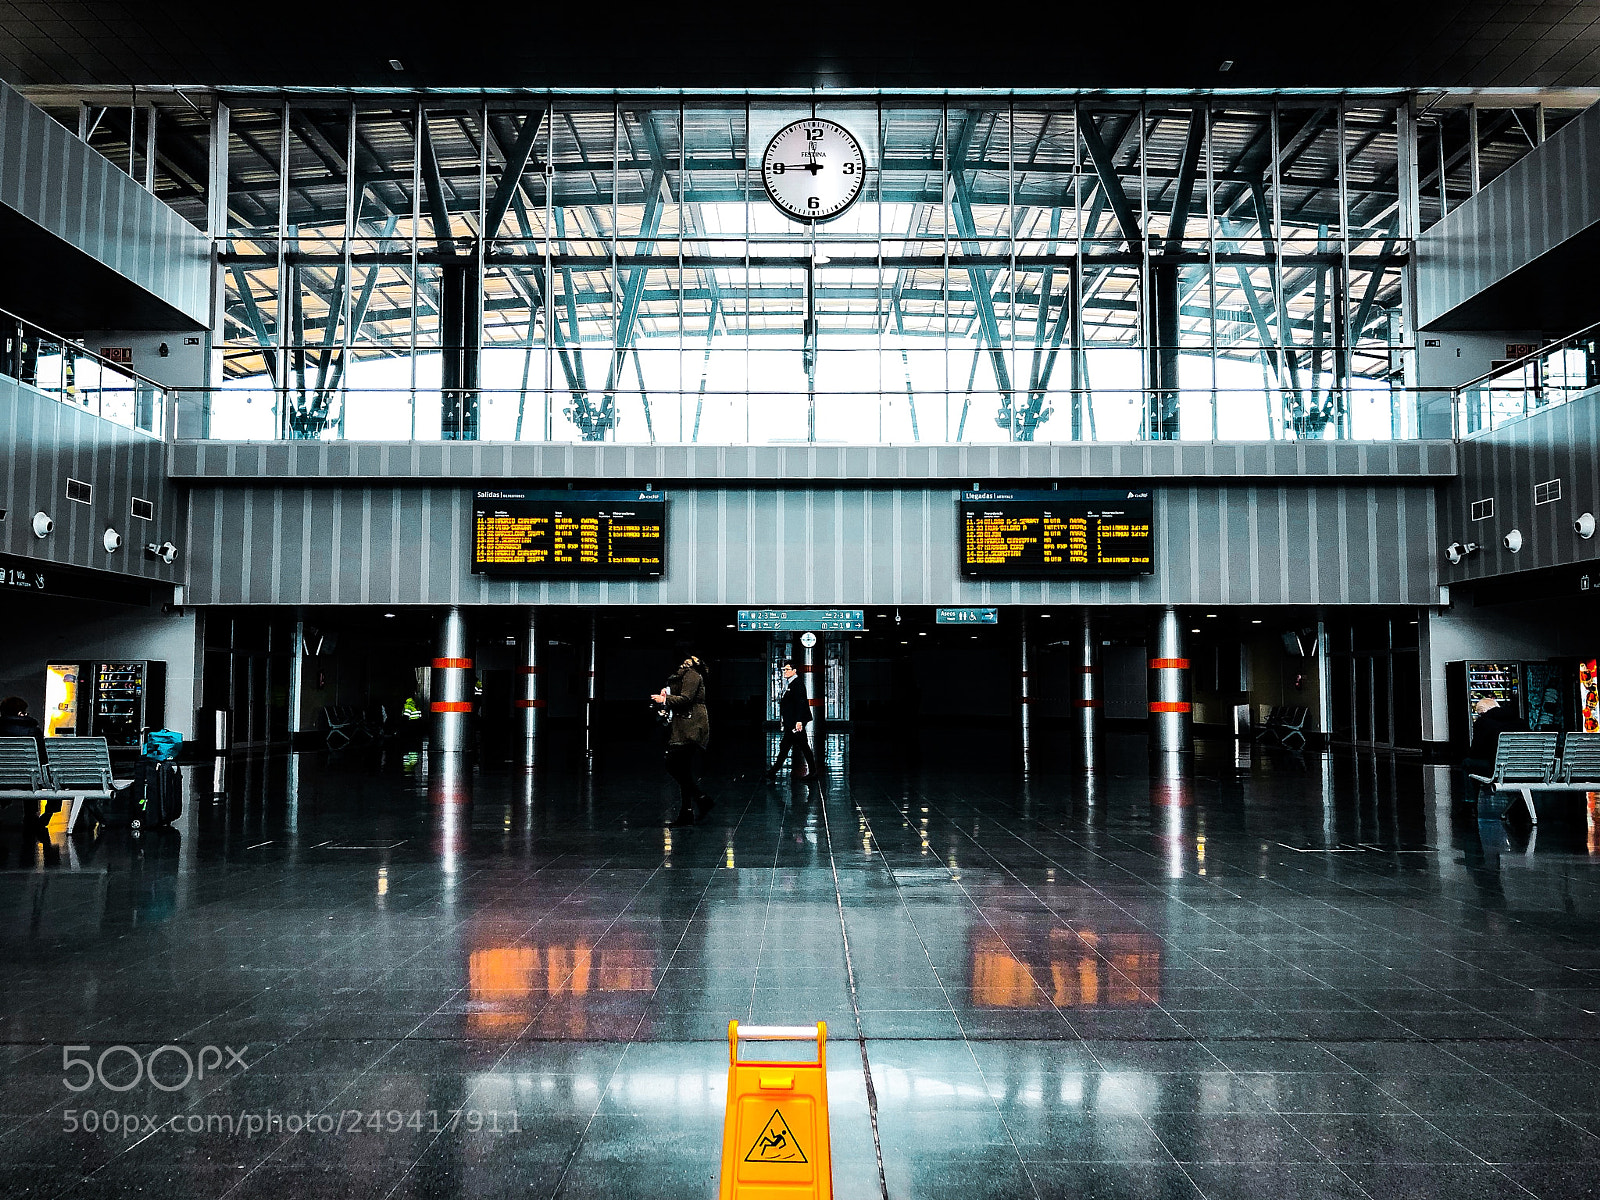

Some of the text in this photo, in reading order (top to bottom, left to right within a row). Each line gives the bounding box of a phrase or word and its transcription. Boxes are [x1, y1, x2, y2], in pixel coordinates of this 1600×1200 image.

[804, 129, 824, 141] 12
[772, 162, 785, 175] 9
[842, 162, 855, 175] 3
[807, 196, 820, 209] 6
[965, 492, 993, 500] Llegadas
[8, 569, 15, 585] 1
